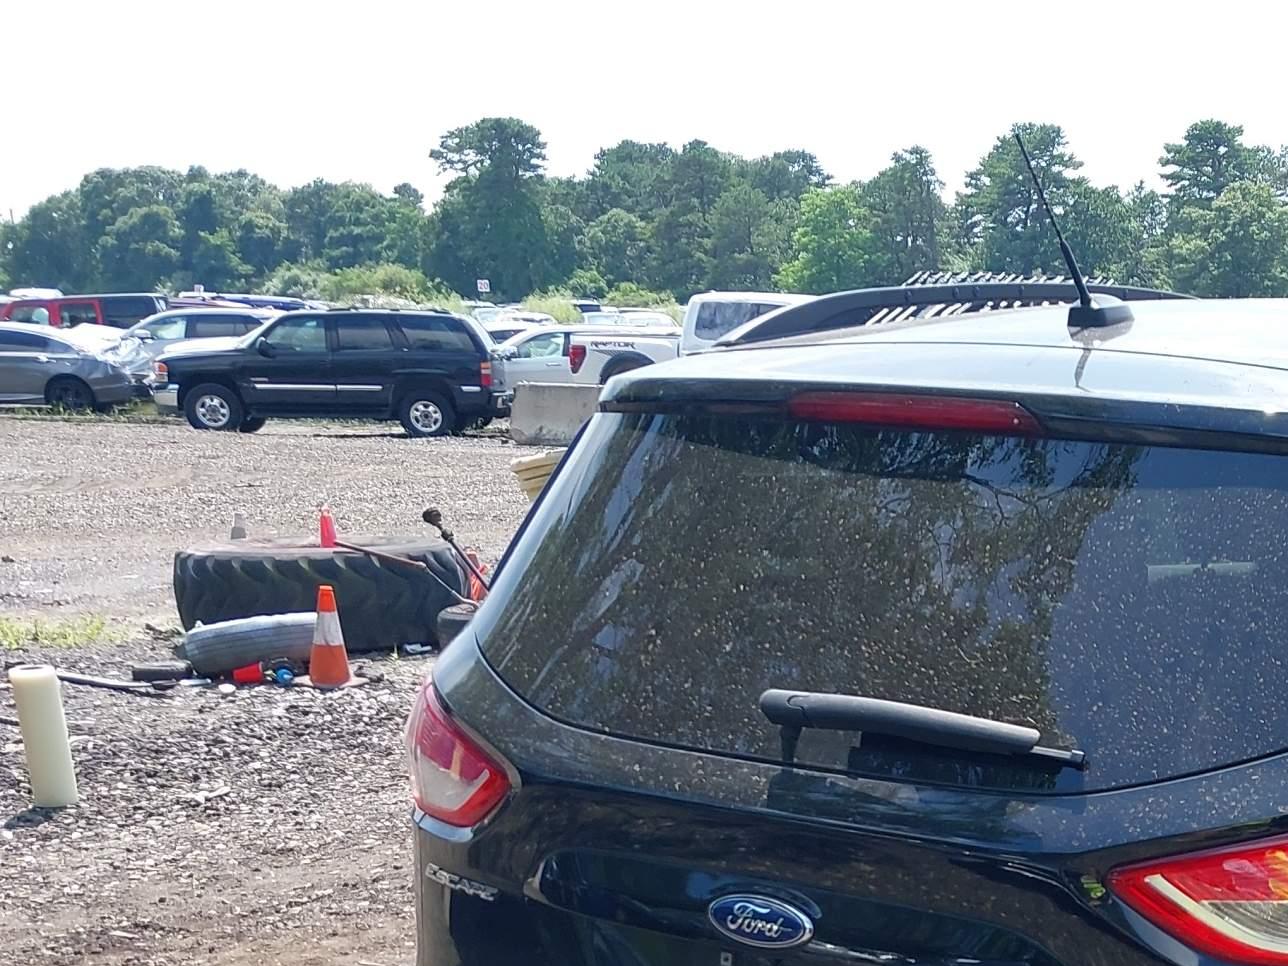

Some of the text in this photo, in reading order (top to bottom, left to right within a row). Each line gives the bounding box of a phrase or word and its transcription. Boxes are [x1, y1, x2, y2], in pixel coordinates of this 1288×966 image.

[478, 280, 489, 290] 20
[590, 340, 636, 350] RAPTOR
[425, 862, 499, 902] ESCAPE
[727, 901, 793, 938] Ford
